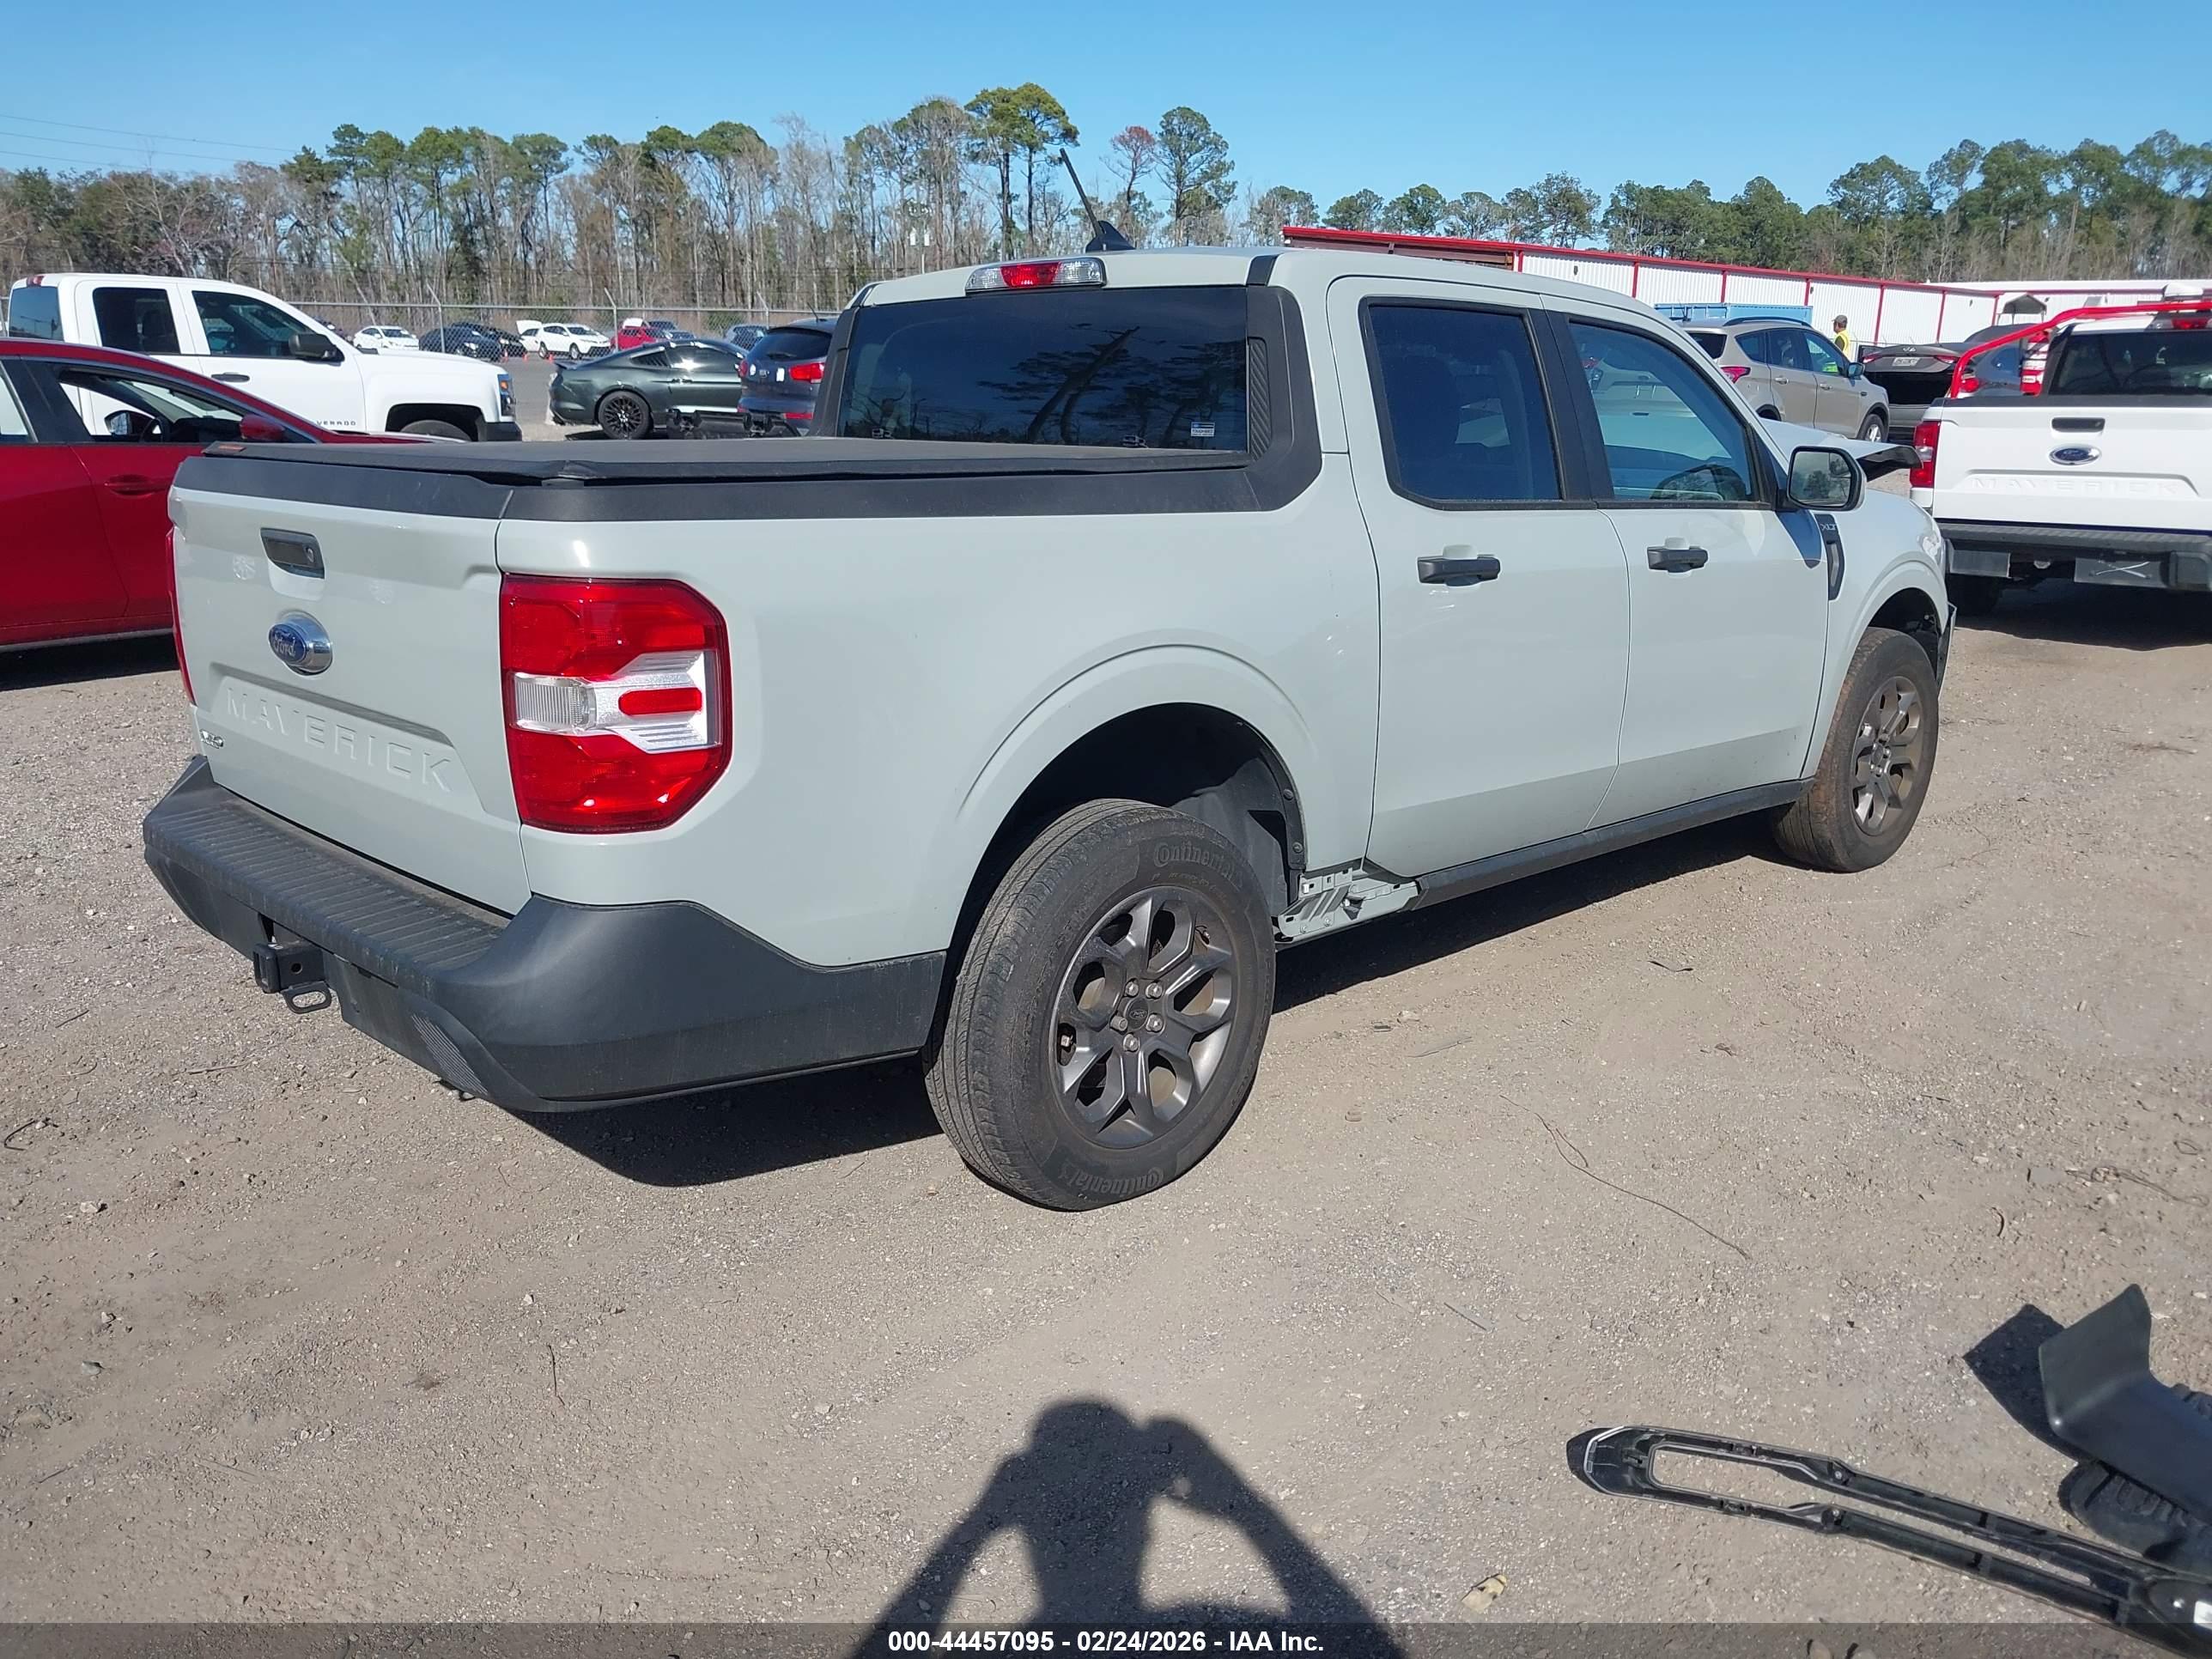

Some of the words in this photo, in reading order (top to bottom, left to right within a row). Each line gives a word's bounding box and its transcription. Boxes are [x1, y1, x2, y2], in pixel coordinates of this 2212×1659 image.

[1972, 477, 2179, 495] MAVERICK
[1818, 521, 1836, 531] XLT
[272, 626, 297, 658] Ford
[228, 688, 452, 790] MAVERICK
[1153, 842, 1236, 882] Continental
[1069, 1167, 1164, 1194] Continental
